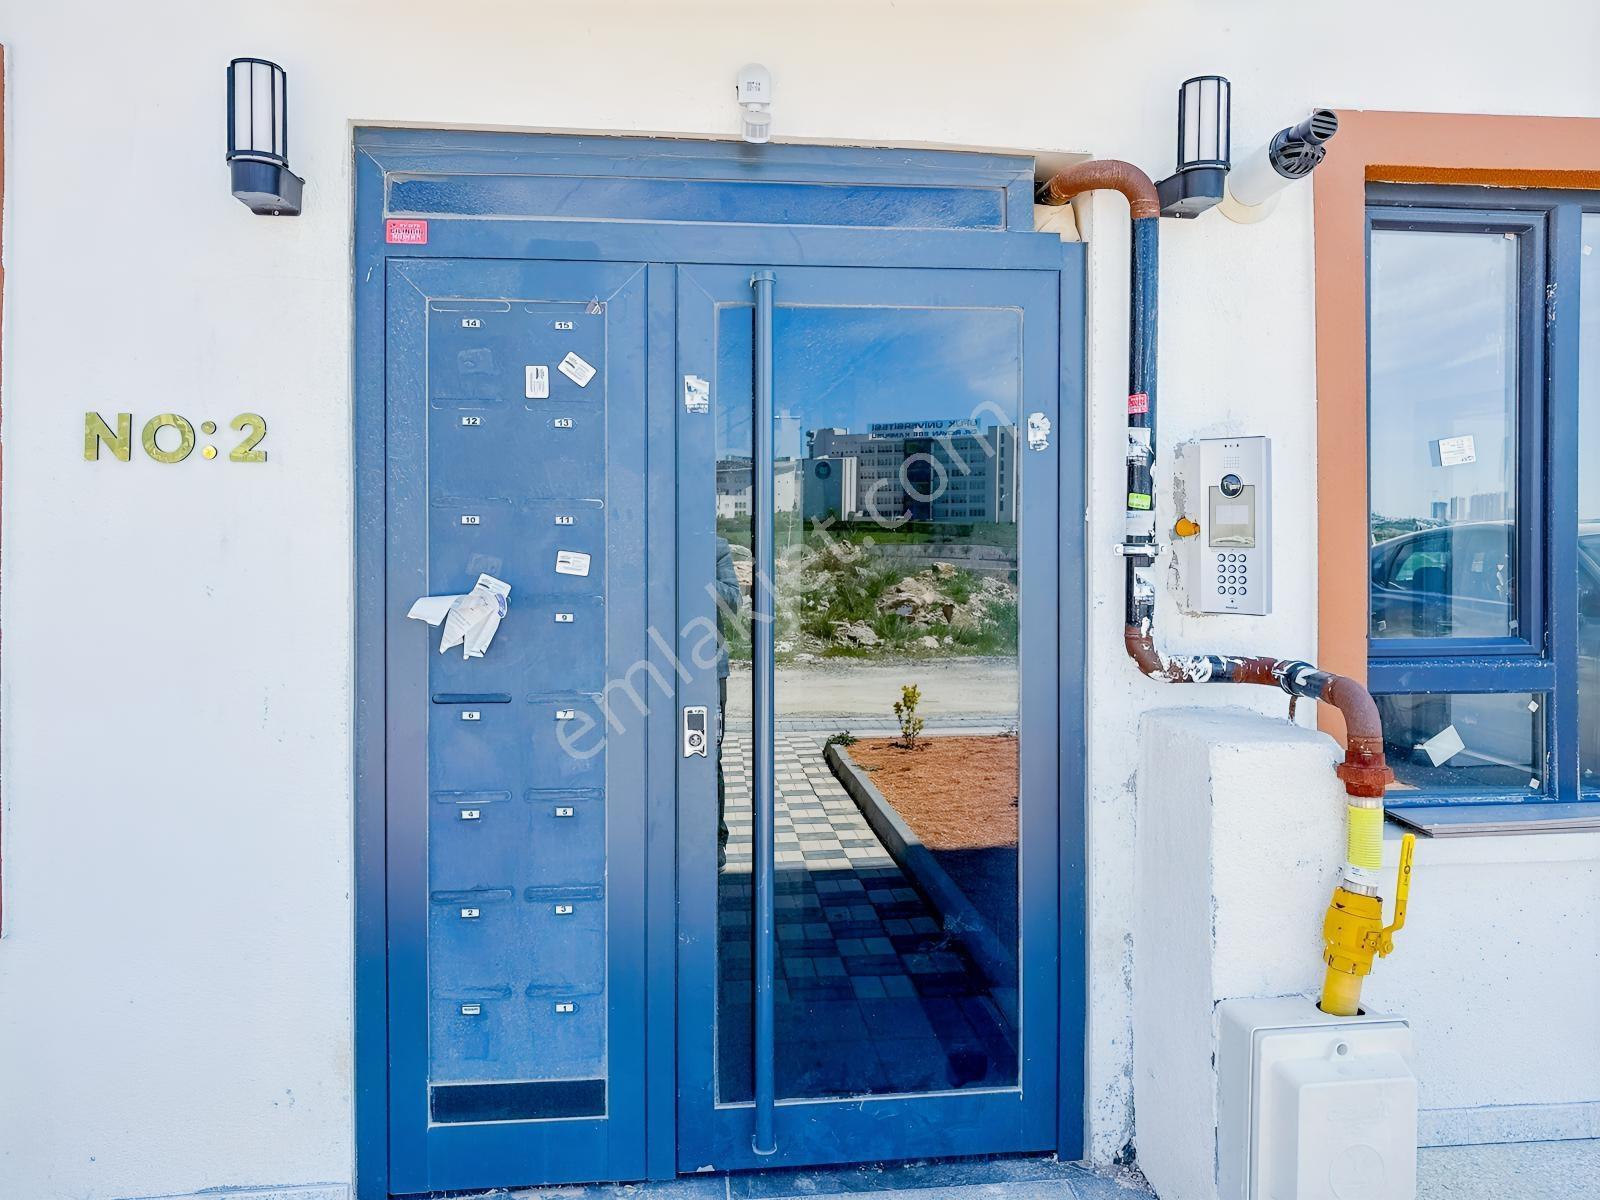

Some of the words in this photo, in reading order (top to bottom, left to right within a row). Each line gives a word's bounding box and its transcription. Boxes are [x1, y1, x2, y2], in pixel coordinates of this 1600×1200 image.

[465, 417, 478, 425] 12
[557, 419, 569, 427] 13
[85, 411, 267, 464] NO:2
[465, 516, 476, 524] 10
